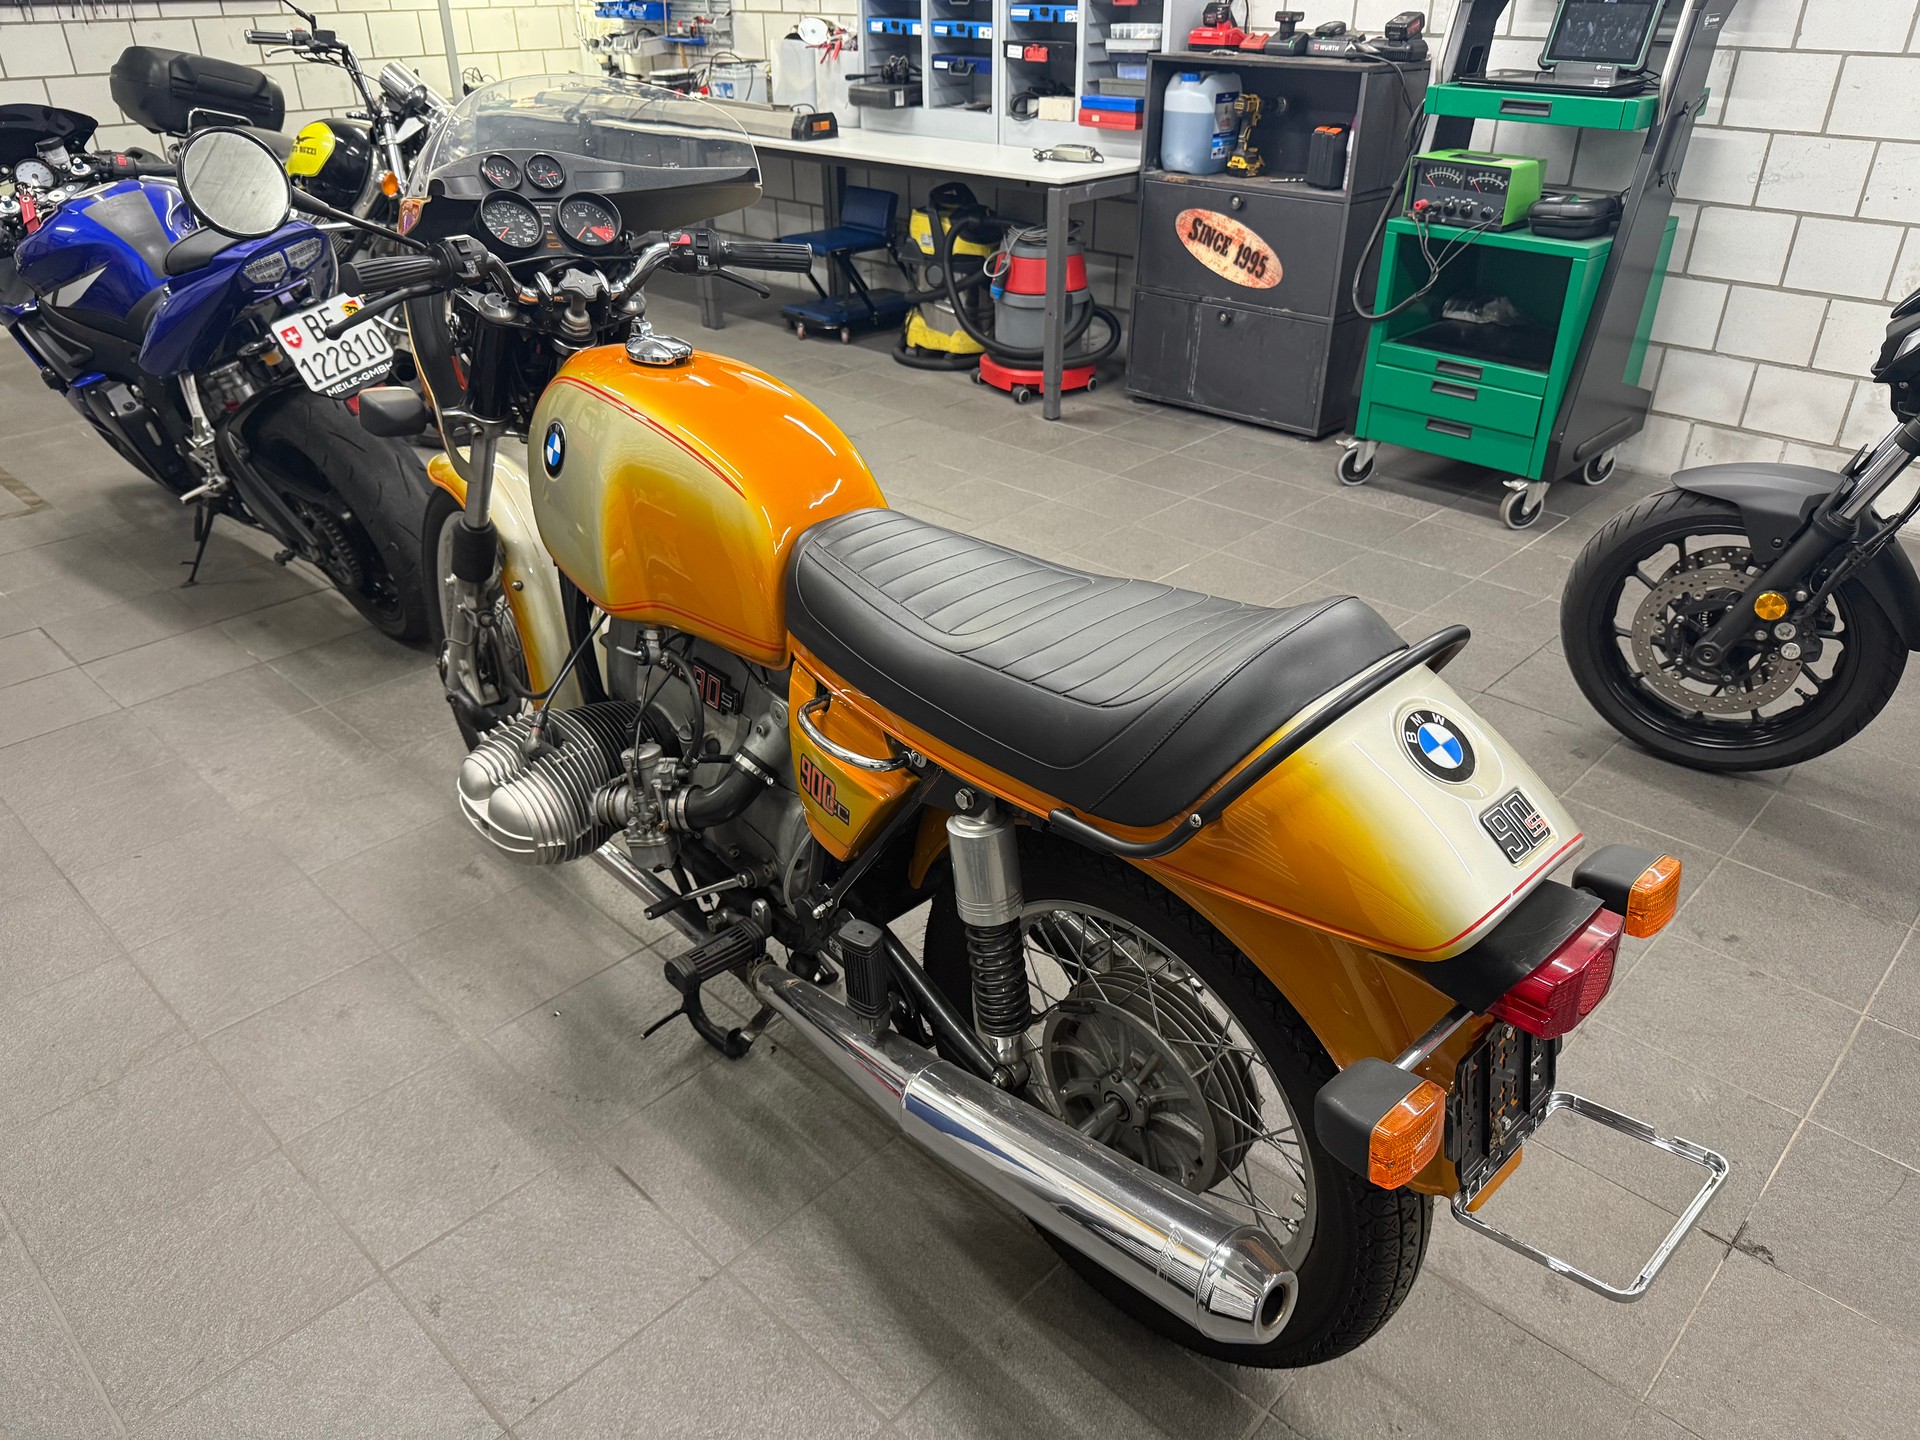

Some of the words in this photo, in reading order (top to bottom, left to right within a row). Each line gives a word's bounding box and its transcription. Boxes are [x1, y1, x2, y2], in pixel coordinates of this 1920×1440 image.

[1187, 217, 1233, 257] SINCE
[1233, 243, 1269, 279] 1995
[300, 328, 387, 385] 122810
[1405, 712, 1446, 744] BMW
